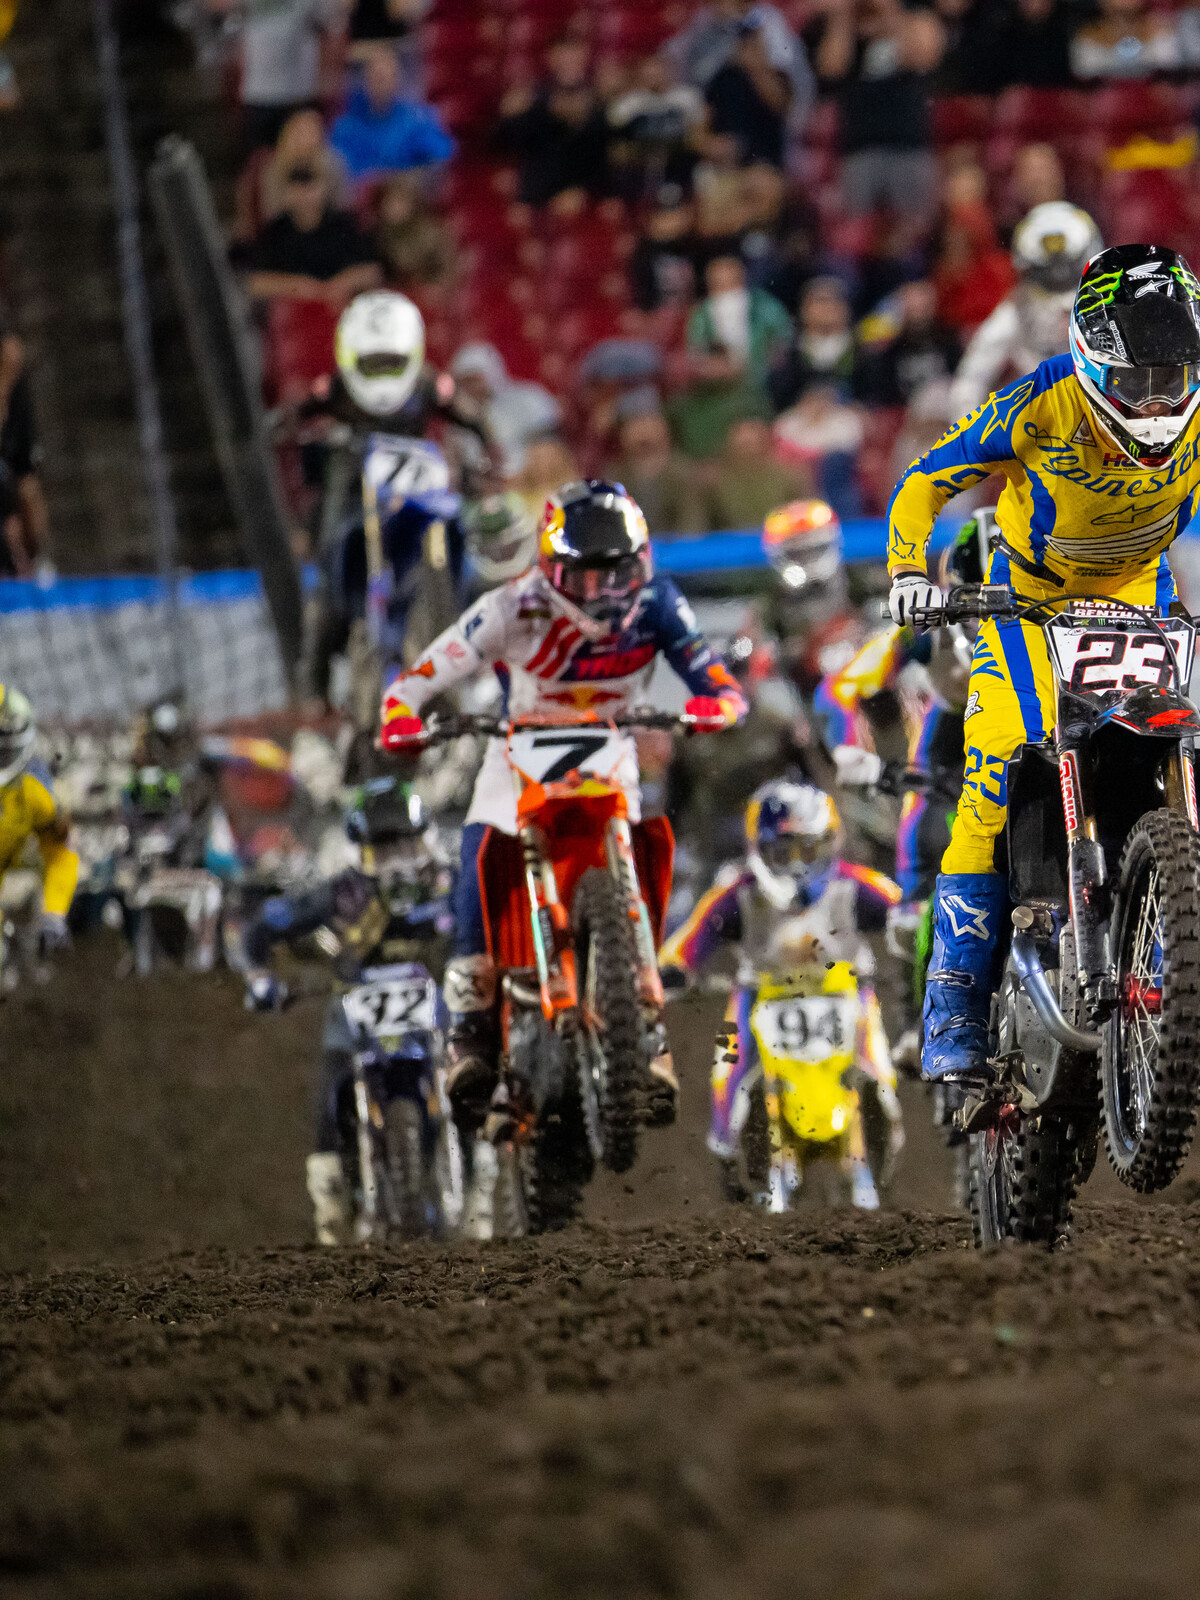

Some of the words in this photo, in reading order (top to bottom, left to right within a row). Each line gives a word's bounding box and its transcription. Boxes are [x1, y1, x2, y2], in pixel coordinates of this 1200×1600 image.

[1073, 600, 1156, 611] RENTAL
[1069, 633, 1180, 694] 23
[532, 736, 609, 783] 7
[777, 1007, 843, 1051] 94
